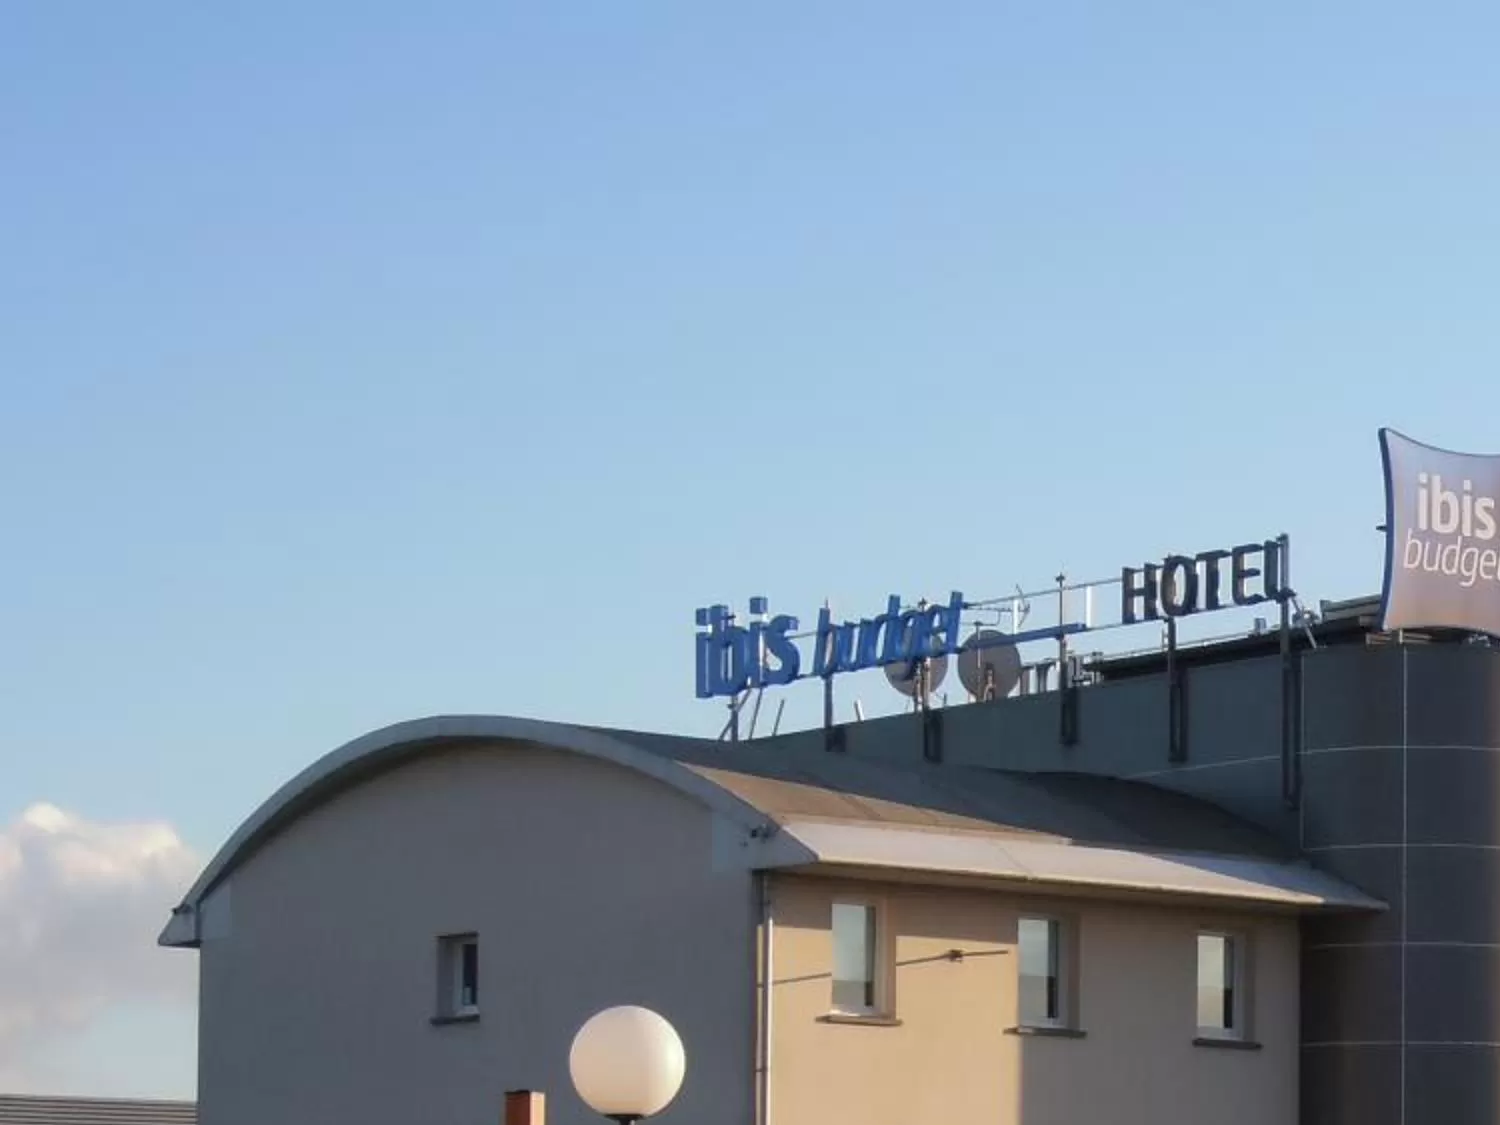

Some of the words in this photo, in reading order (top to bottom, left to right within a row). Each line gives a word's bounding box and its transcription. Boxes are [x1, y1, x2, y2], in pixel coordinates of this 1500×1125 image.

[1418, 472, 1497, 540] ibis
[695, 596, 800, 698] ibis
[812, 590, 963, 677] budget
[1121, 536, 1288, 625] HOTEL
